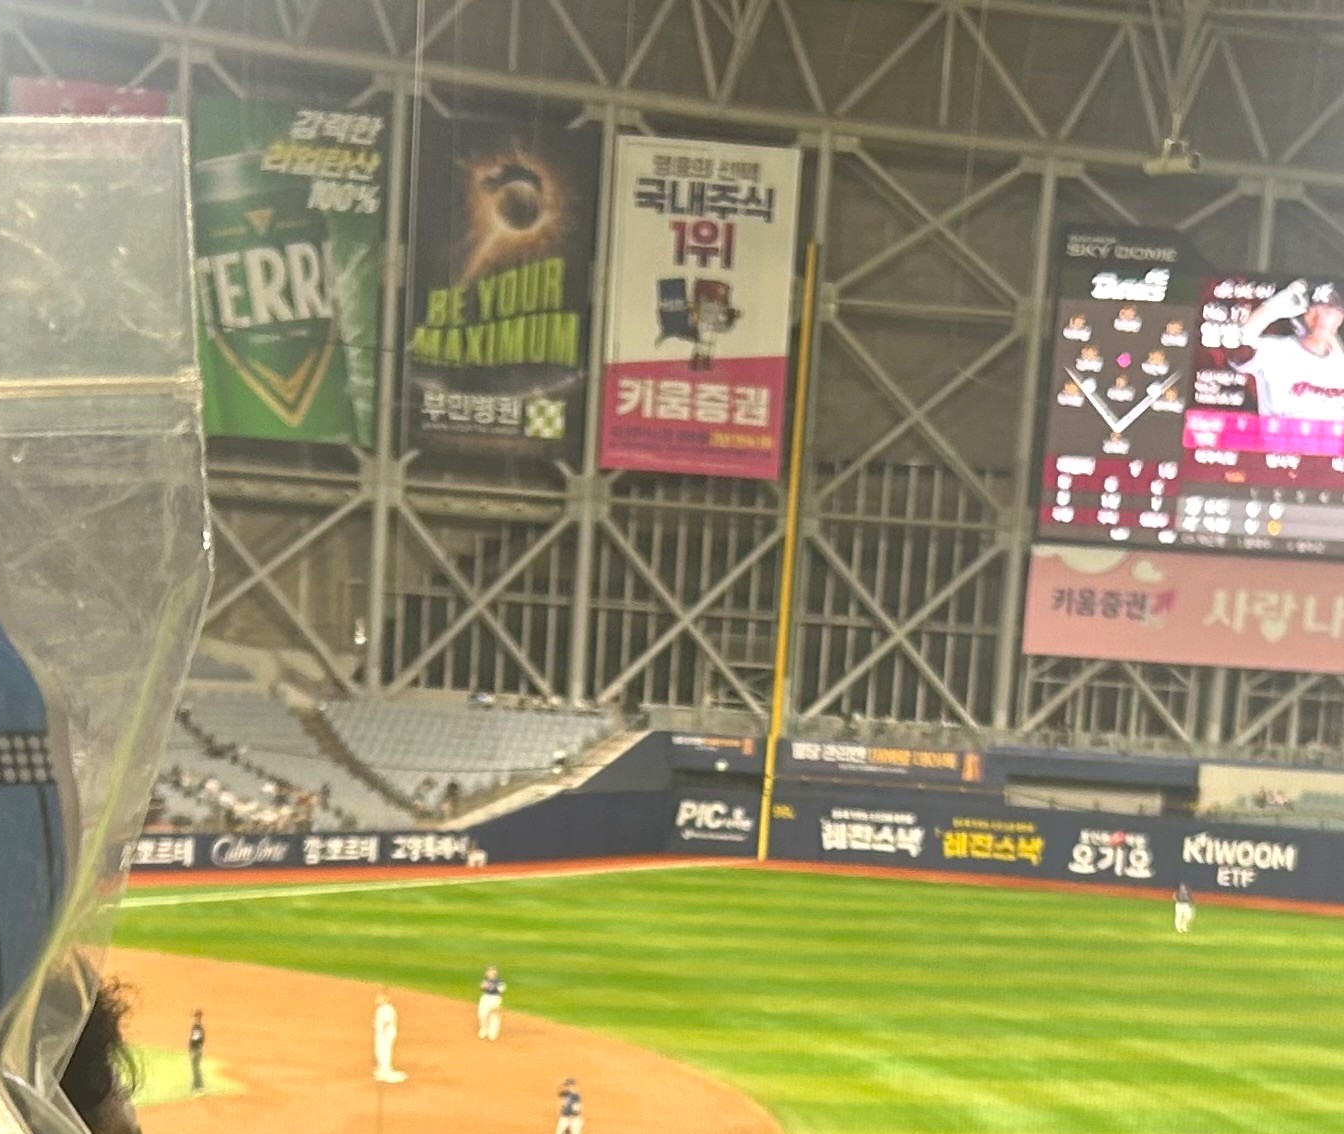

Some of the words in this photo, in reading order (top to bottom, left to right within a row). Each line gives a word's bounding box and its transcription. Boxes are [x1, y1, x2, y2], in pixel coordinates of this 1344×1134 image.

[635, 177, 775, 224] 국내주식
[670, 220, 736, 269] 1위
[1067, 243, 1111, 258] SKY
[426, 283, 467, 326] BE
[479, 257, 564, 320] YOUR
[412, 313, 578, 367] MAXIMUM
[616, 378, 770, 427] 키움증권
[1052, 588, 1149, 621] 키움증권
[1203, 589, 1296, 643] 사랑
[1068, 843, 1155, 878] 요기요
[1183, 831, 1298, 871] KIWOOM
[1216, 866, 1258, 888] ETF
